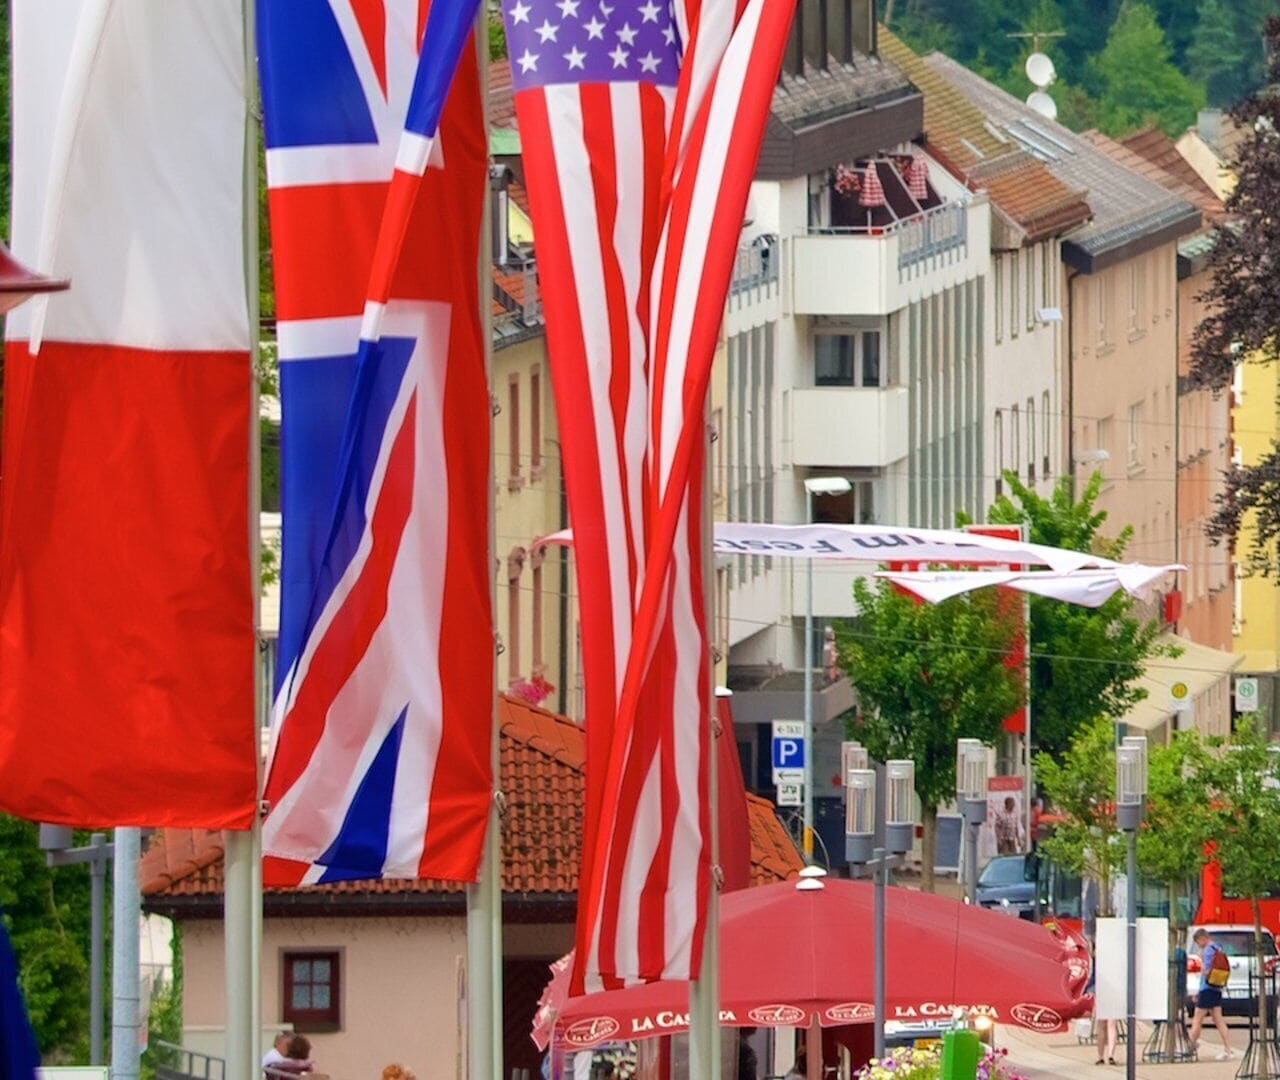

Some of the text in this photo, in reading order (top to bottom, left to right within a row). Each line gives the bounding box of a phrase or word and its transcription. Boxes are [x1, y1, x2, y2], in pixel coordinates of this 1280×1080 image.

[779, 740, 798, 765] P
[632, 1010, 736, 1032] LA CASTA
[895, 1006, 917, 1017] LA
